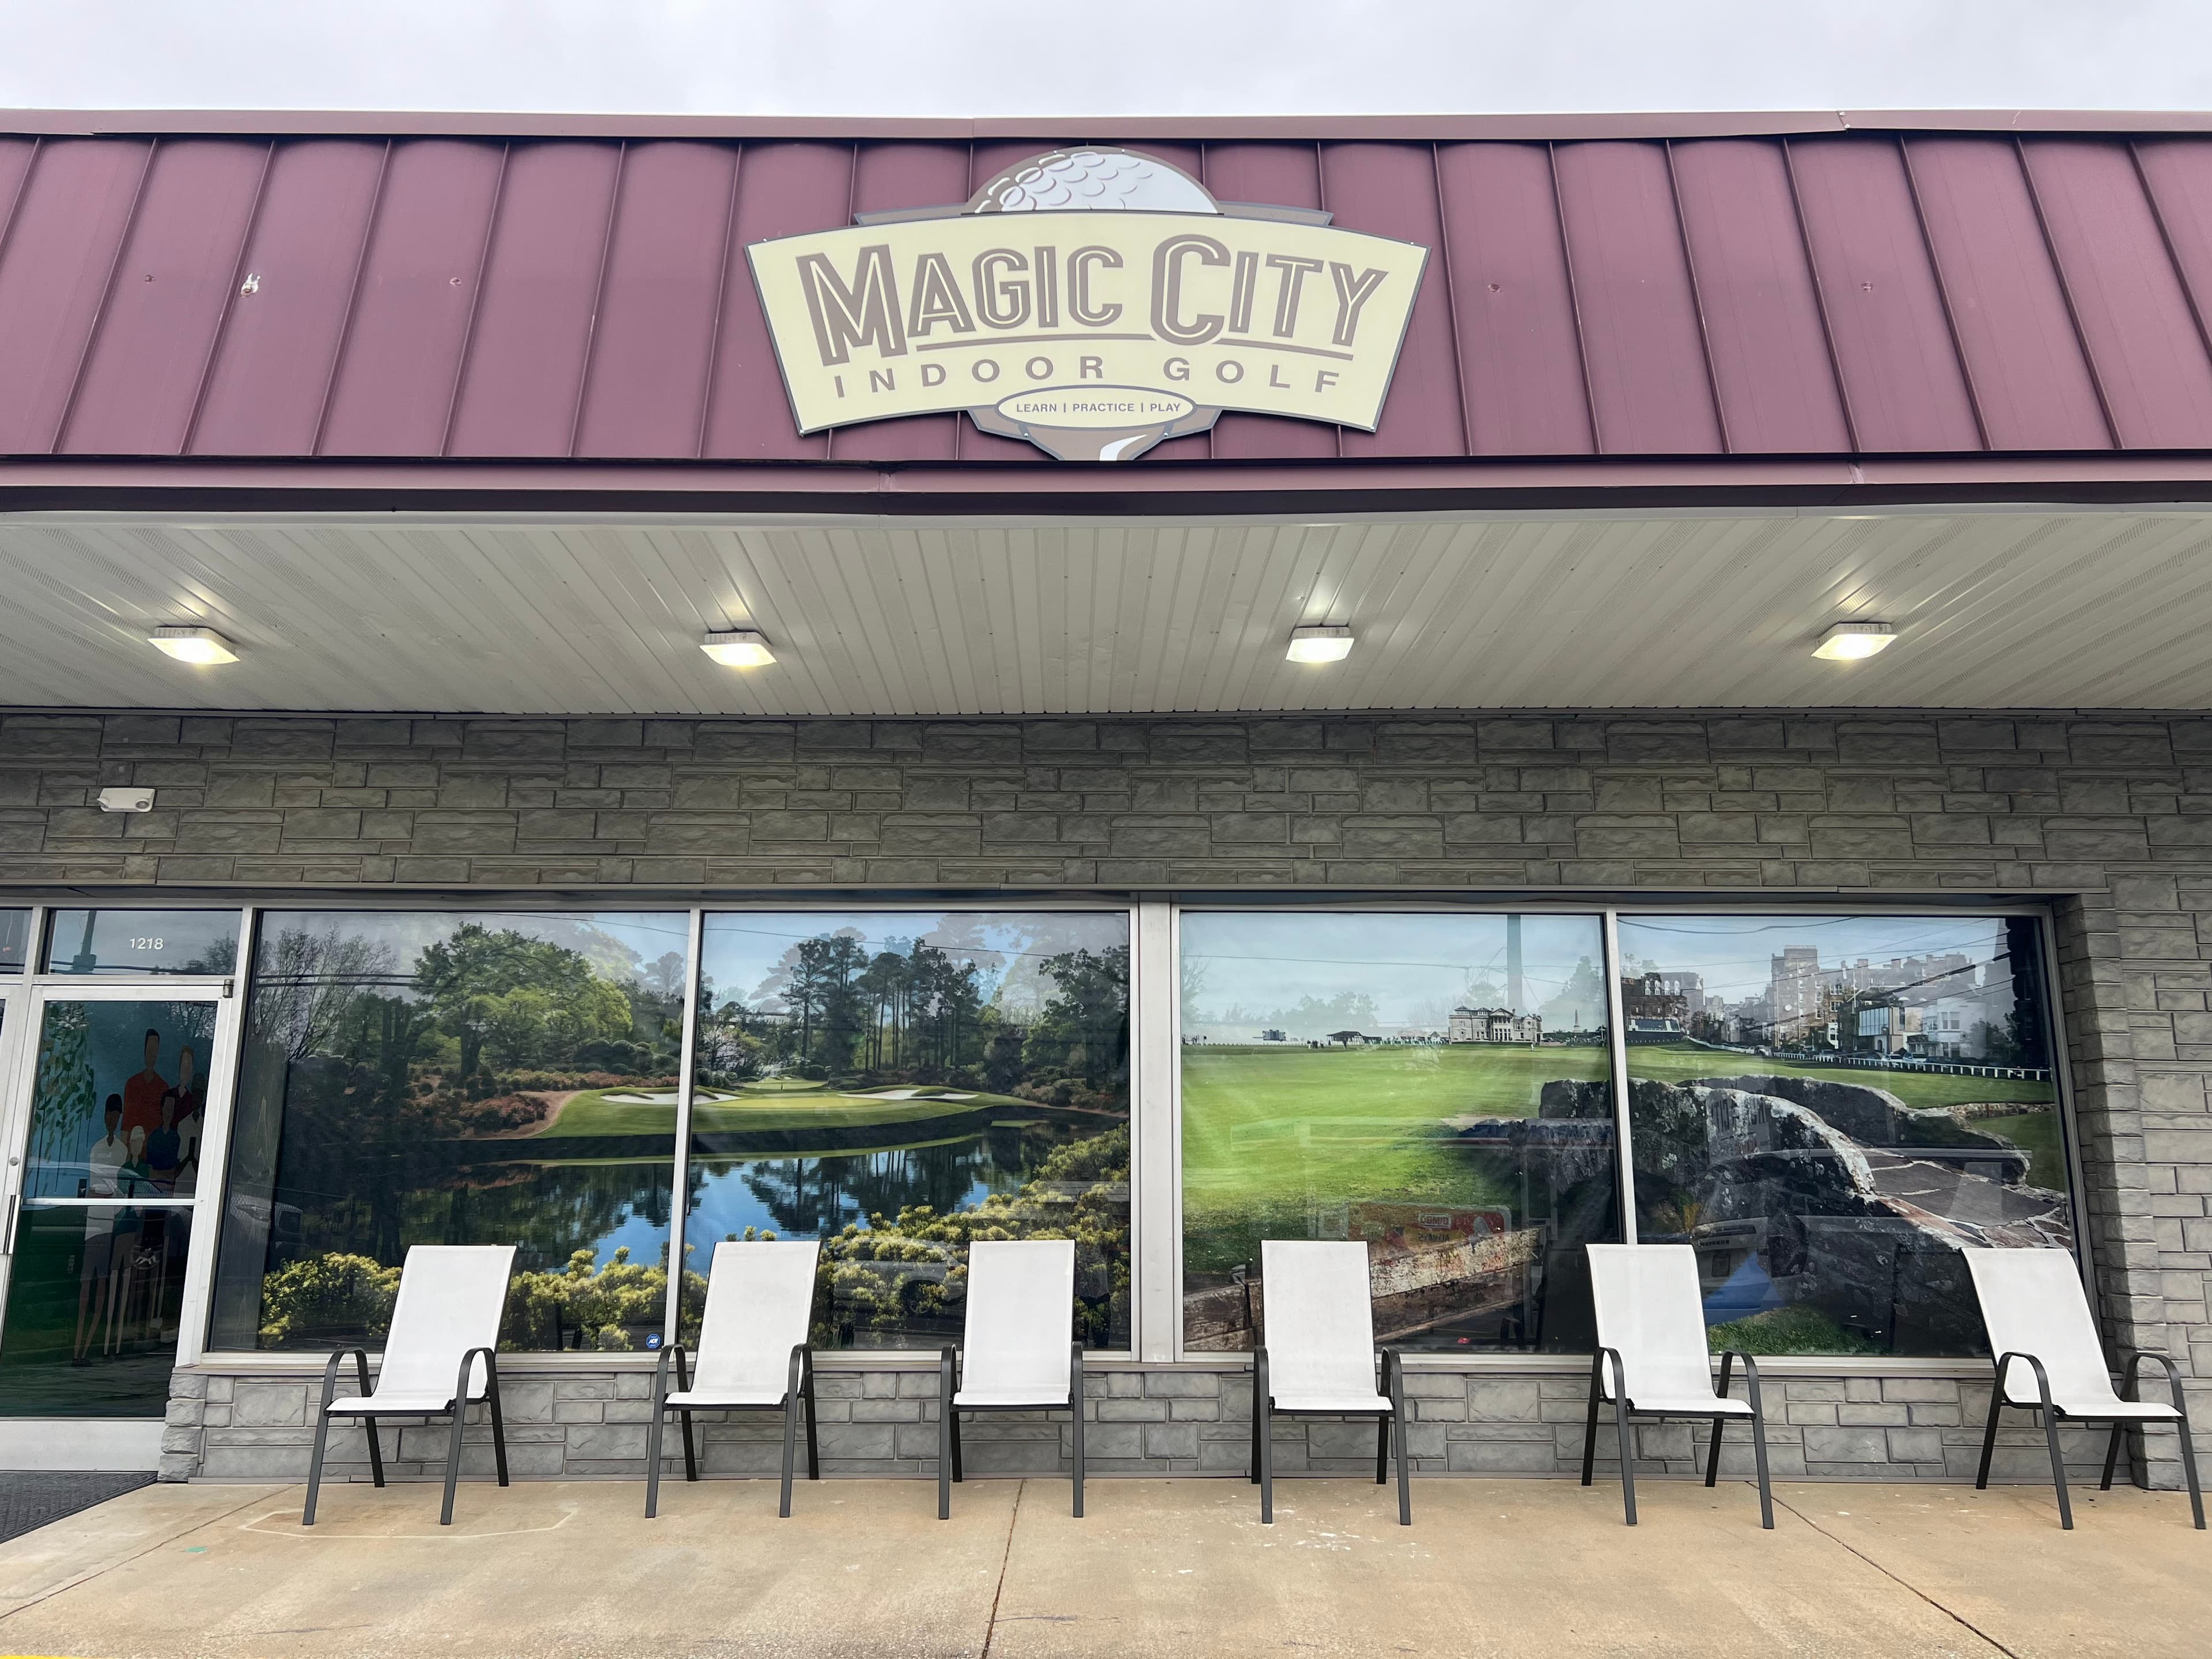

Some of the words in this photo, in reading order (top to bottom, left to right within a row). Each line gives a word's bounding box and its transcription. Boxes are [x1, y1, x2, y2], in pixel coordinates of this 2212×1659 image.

[796, 243, 1124, 367] MAGIC
[1150, 233, 1389, 348] CITY
[834, 355, 1103, 399] INDOOR
[1163, 356, 1339, 393] GOLF
[1016, 403, 1058, 413] LEARN
[1072, 403, 1135, 412] PRACTICE
[1149, 402, 1181, 412] PLAY
[130, 937, 164, 950] 1218
